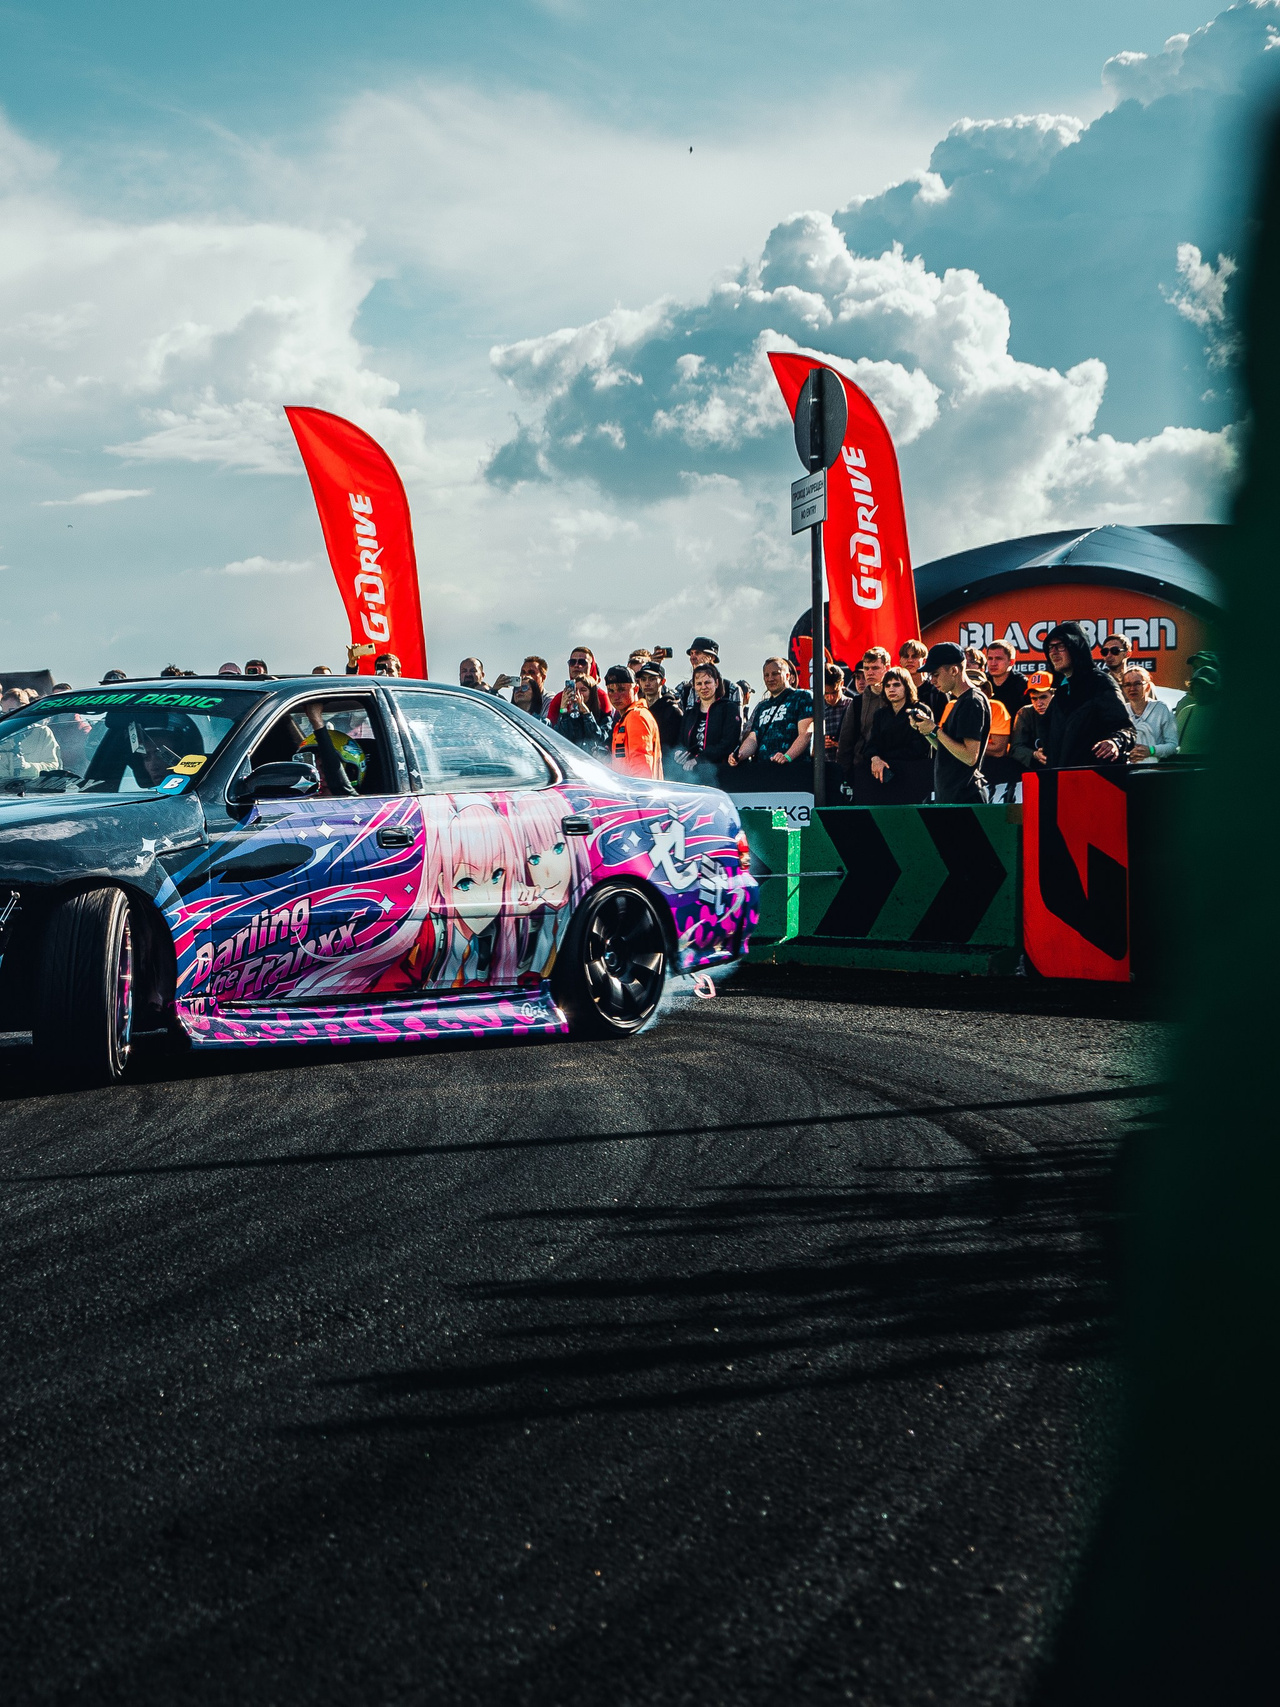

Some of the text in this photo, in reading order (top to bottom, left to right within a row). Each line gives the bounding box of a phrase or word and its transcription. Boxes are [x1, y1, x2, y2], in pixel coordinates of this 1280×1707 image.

[960, 617, 1177, 651] BLACBURN
[32, 693, 223, 711] TSUNAMI PICNIC
[163, 777, 183, 790] B
[192, 898, 310, 989] Darling
